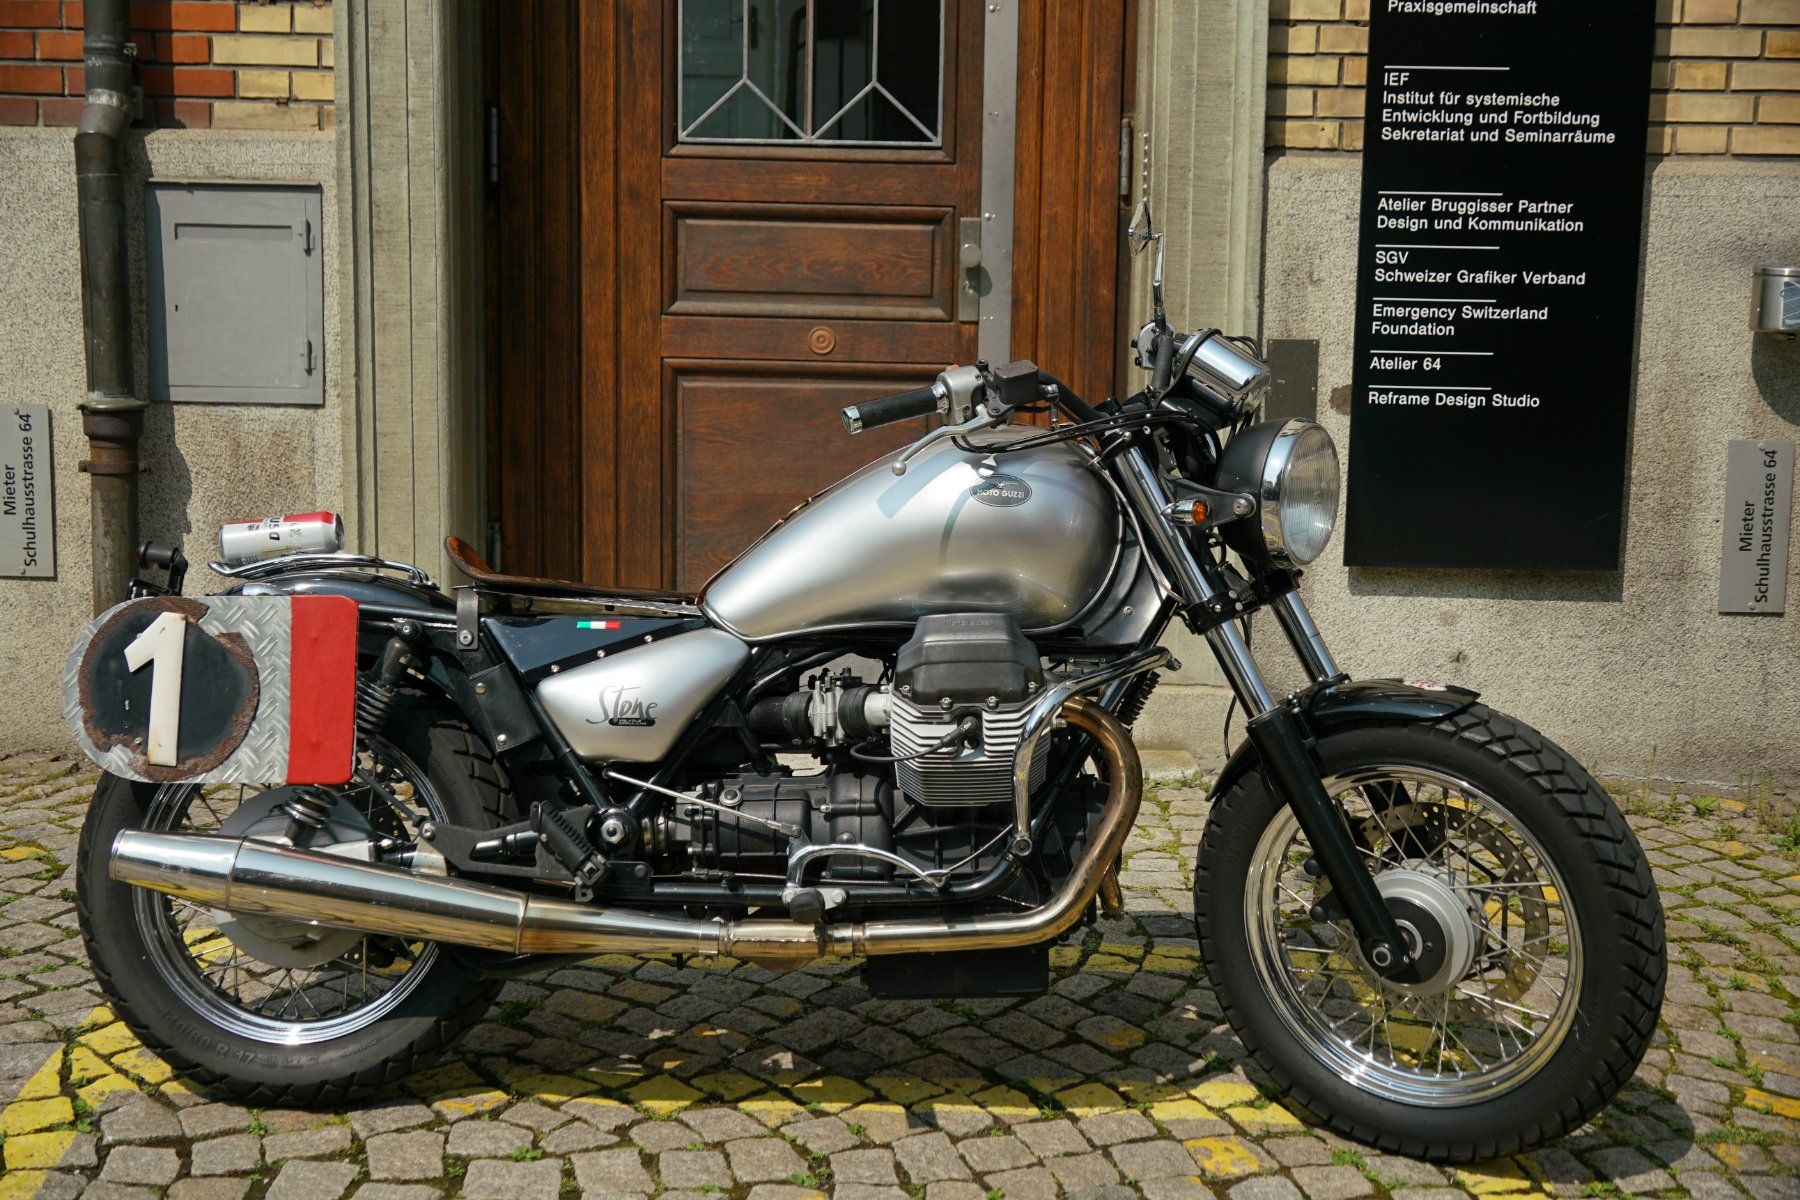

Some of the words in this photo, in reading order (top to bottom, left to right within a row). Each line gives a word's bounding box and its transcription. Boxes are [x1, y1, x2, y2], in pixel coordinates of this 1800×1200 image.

[1387, 0, 1538, 16] Praxisgemeinschaft
[1384, 72, 1410, 86] IEF
[1383, 90, 1435, 105] Institut
[1439, 90, 1461, 105] für
[1465, 92, 1560, 108] systemische
[1382, 108, 1474, 127] Entwicklung
[1479, 110, 1508, 124] und
[1513, 110, 1600, 128] Fortbildung
[1381, 126, 1465, 142] Sekretariat
[1470, 128, 1499, 142] und
[1504, 128, 1616, 144] Seminarräume
[1377, 197, 1427, 212] Atelier
[1431, 198, 1514, 215] Bruggisser
[1518, 199, 1574, 214] Partner
[1377, 214, 1428, 232] Design
[1434, 216, 1463, 230] und
[1468, 216, 1584, 232] Kommunikation
[1375, 250, 1409, 265] SGV
[1374, 267, 1452, 283] Schweizer
[1456, 269, 1518, 284] Grafiker
[1522, 270, 1586, 286] Verband
[1372, 303, 1457, 321] Emergency
[1461, 305, 1548, 320] Switzerland
[1371, 321, 1455, 336] Foundation
[1369, 356, 1418, 371] Atelier
[1422, 357, 1442, 371] 64
[1368, 391, 1430, 406] Reframe
[1435, 392, 1486, 409] Design
[1491, 393, 1540, 408] Studio
[19, 412, 32, 432] 64
[1763, 449, 1778, 468] 64
[3, 464, 16, 515] Mieter
[1001, 490, 1025, 499] GUZZI
[22, 436, 37, 567] Schulhausstrasse
[1739, 500, 1755, 552] Mieter
[1754, 473, 1776, 603] Schulhausstrasse
[124, 611, 187, 767] 1
[585, 683, 658, 724] Stone
